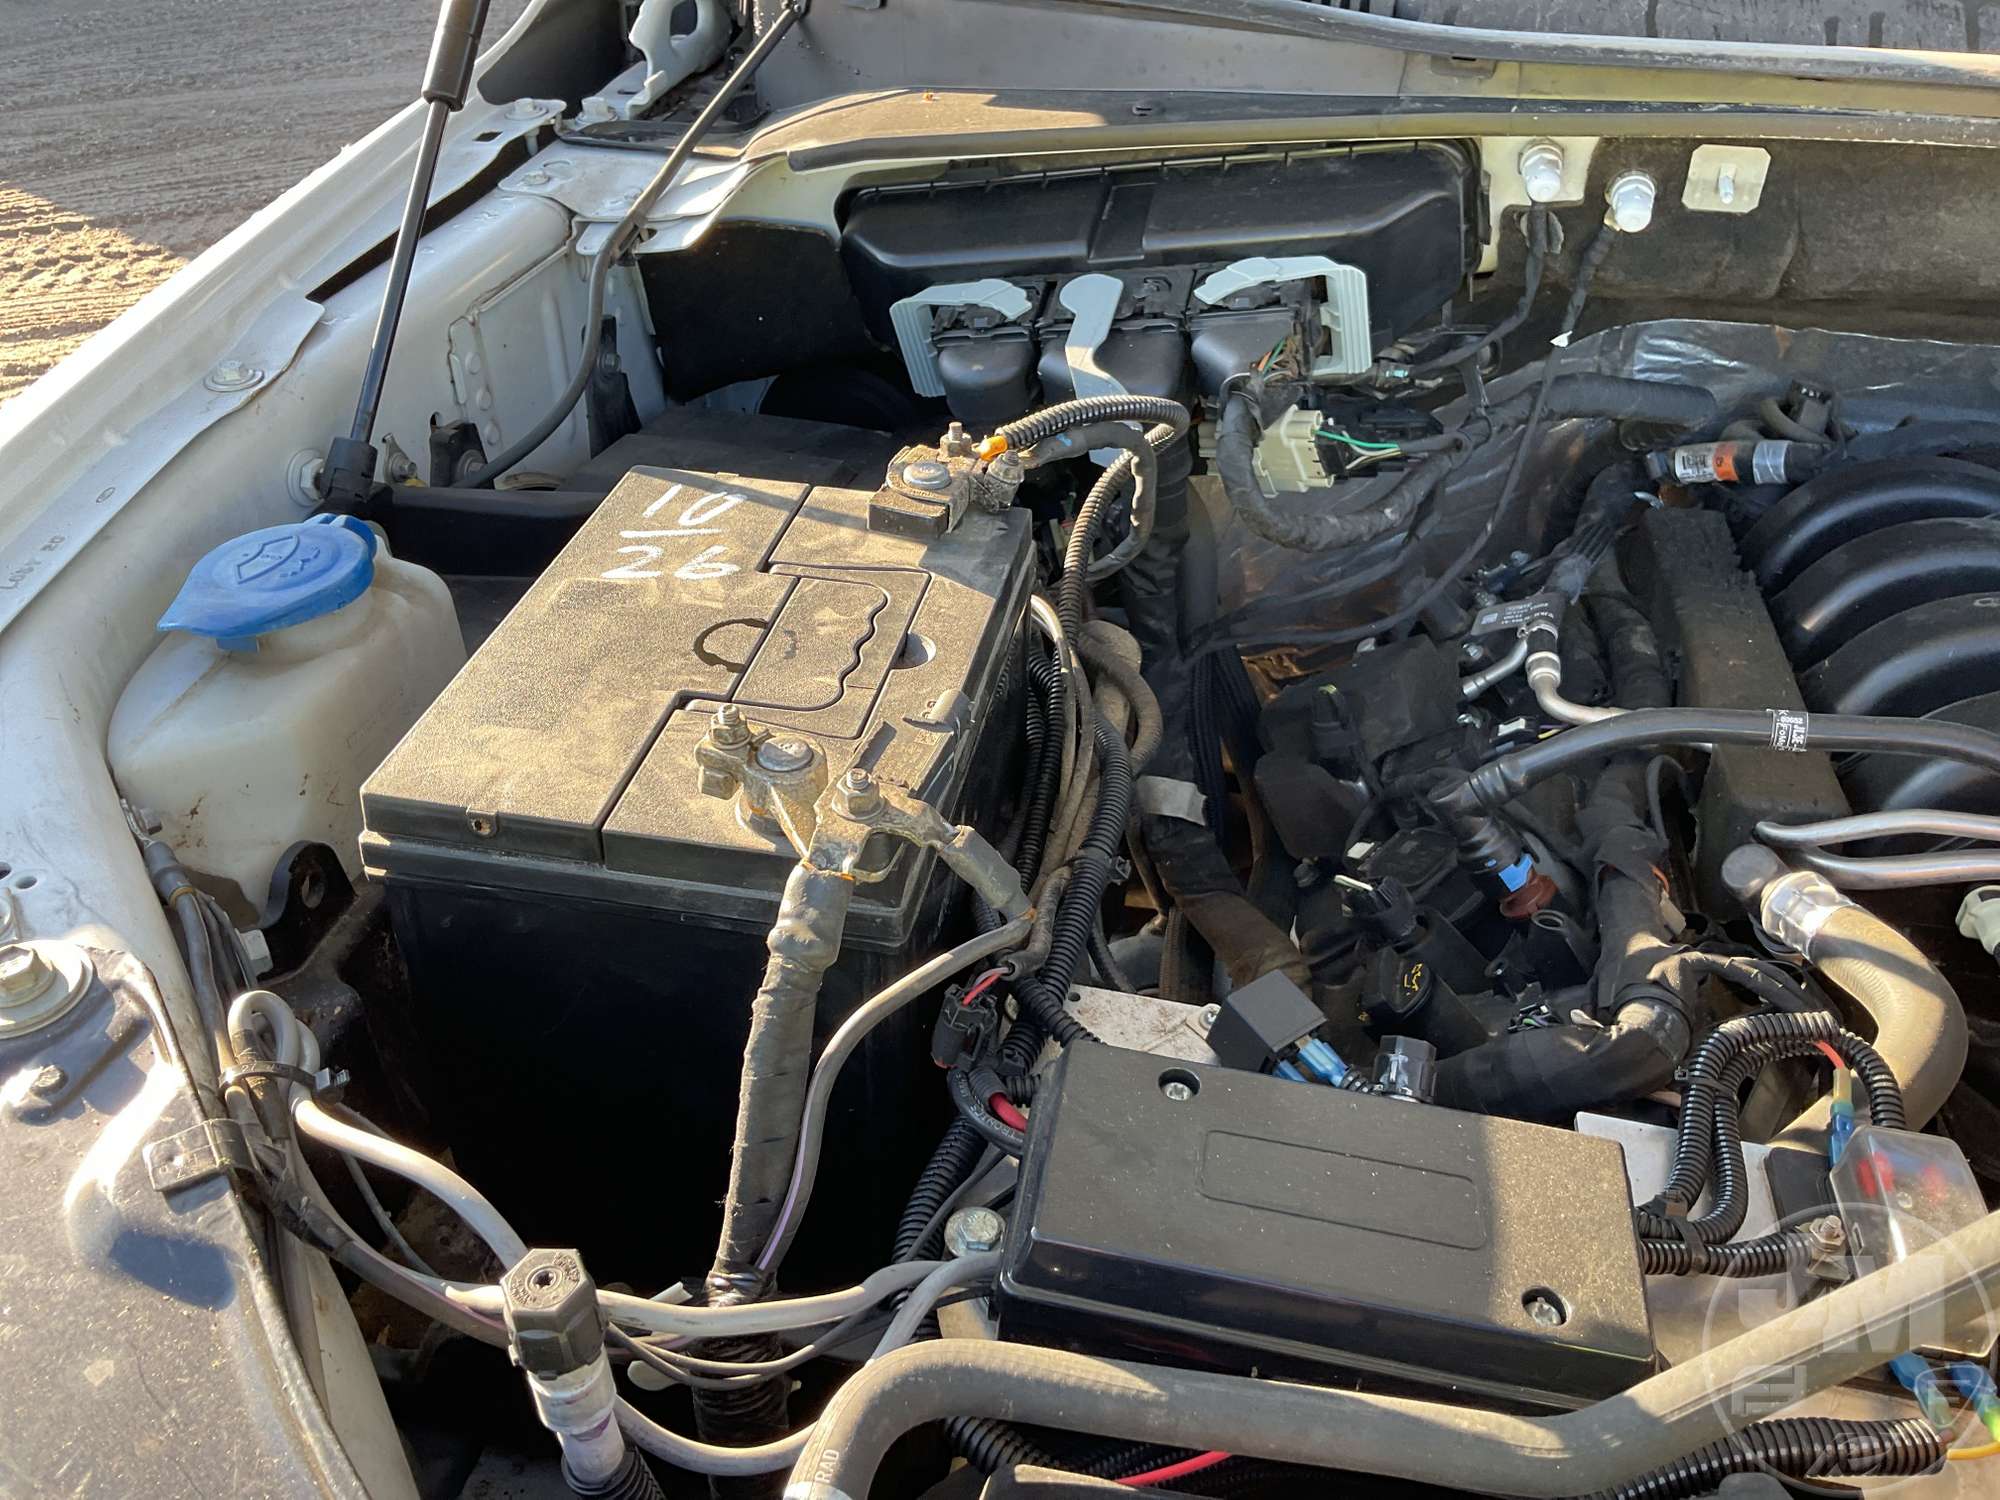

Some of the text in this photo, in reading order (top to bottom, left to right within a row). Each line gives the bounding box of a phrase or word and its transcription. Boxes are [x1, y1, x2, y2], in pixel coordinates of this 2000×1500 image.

[642, 483, 748, 527] 10
[600, 543, 742, 580] 26
[814, 1449, 840, 1484] RAD
